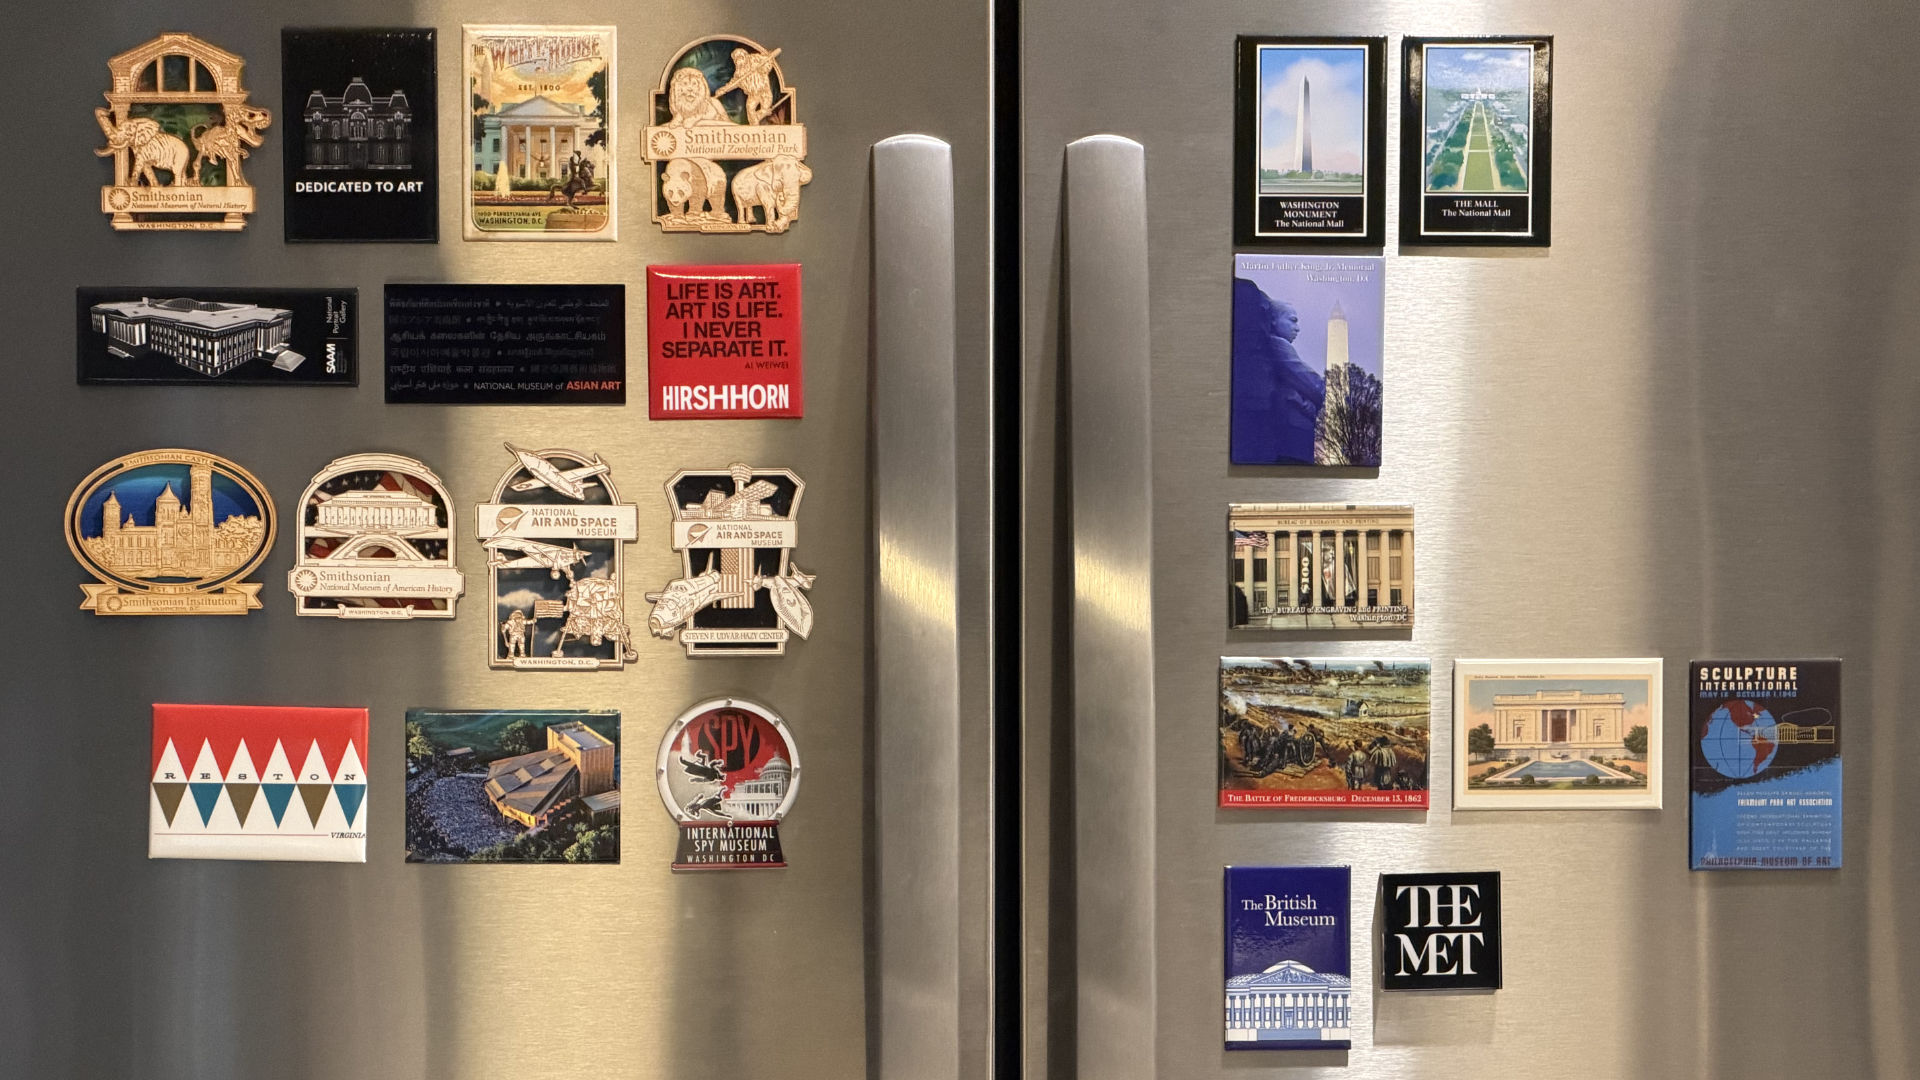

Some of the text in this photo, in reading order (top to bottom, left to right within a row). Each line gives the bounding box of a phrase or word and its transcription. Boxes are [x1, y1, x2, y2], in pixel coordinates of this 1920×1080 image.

[471, 44, 484, 56] THE
[549, 35, 601, 67] HOUSE
[684, 130, 787, 144] Smithsonian
[684, 144, 799, 156] National Zoological Park
[295, 181, 424, 193] DEDICATED TO ART
[132, 191, 203, 201] Smithsonian
[1454, 200, 1499, 208] THE MALL
[1283, 210, 1337, 218] MONUMENT
[1442, 209, 1511, 217] The National Mall
[1241, 262, 1269, 270] Martin
[1337, 263, 1375, 271] Memorial
[667, 282, 782, 300] LIFE IS ART.
[325, 296, 333, 324] National
[340, 300, 348, 324] Gallery
[665, 301, 783, 319] ART IS LIFE.
[683, 321, 761, 339] I NEVER
[662, 340, 788, 358] SEPARATE IT.
[326, 343, 336, 374] SAAM
[756, 361, 789, 370] WEIWEI
[473, 381, 622, 390] NATIONAL MUSEUM of ASIAN ART
[662, 384, 789, 411] HIRSHHORN
[531, 508, 578, 517] NATIONAL
[531, 518, 617, 527] AIR AND SPACE
[577, 528, 617, 536] MUSEUM
[716, 531, 783, 539] AIR AND SPACE
[319, 571, 391, 582] Smithsonian
[319, 582, 453, 594] National Museum of American History
[122, 596, 237, 607] Smithsonian Institution
[1277, 606, 1306, 614] BUREAU
[1315, 606, 1357, 614] ENGRAVING
[1372, 606, 1408, 614] PRINTING
[685, 632, 710, 640] STEVEN
[759, 632, 784, 640] CENTER
[1700, 667, 1798, 681] SCULPTURE
[1700, 681, 1798, 691] INTERNATIONAL
[702, 714, 755, 768] SPY
[687, 826, 775, 840] INTERNATIONAL
[694, 840, 767, 852] SPY MUSEUM
[687, 853, 775, 863] WASHINGTON DC
[1761, 857, 1798, 866] MUSEUM
[1802, 857, 1812, 866] OF
[1816, 857, 1831, 866] ART
[1241, 894, 1318, 911] The British
[1395, 884, 1482, 929] THE
[1264, 911, 1336, 926] Museum
[1393, 932, 1485, 977] MET
